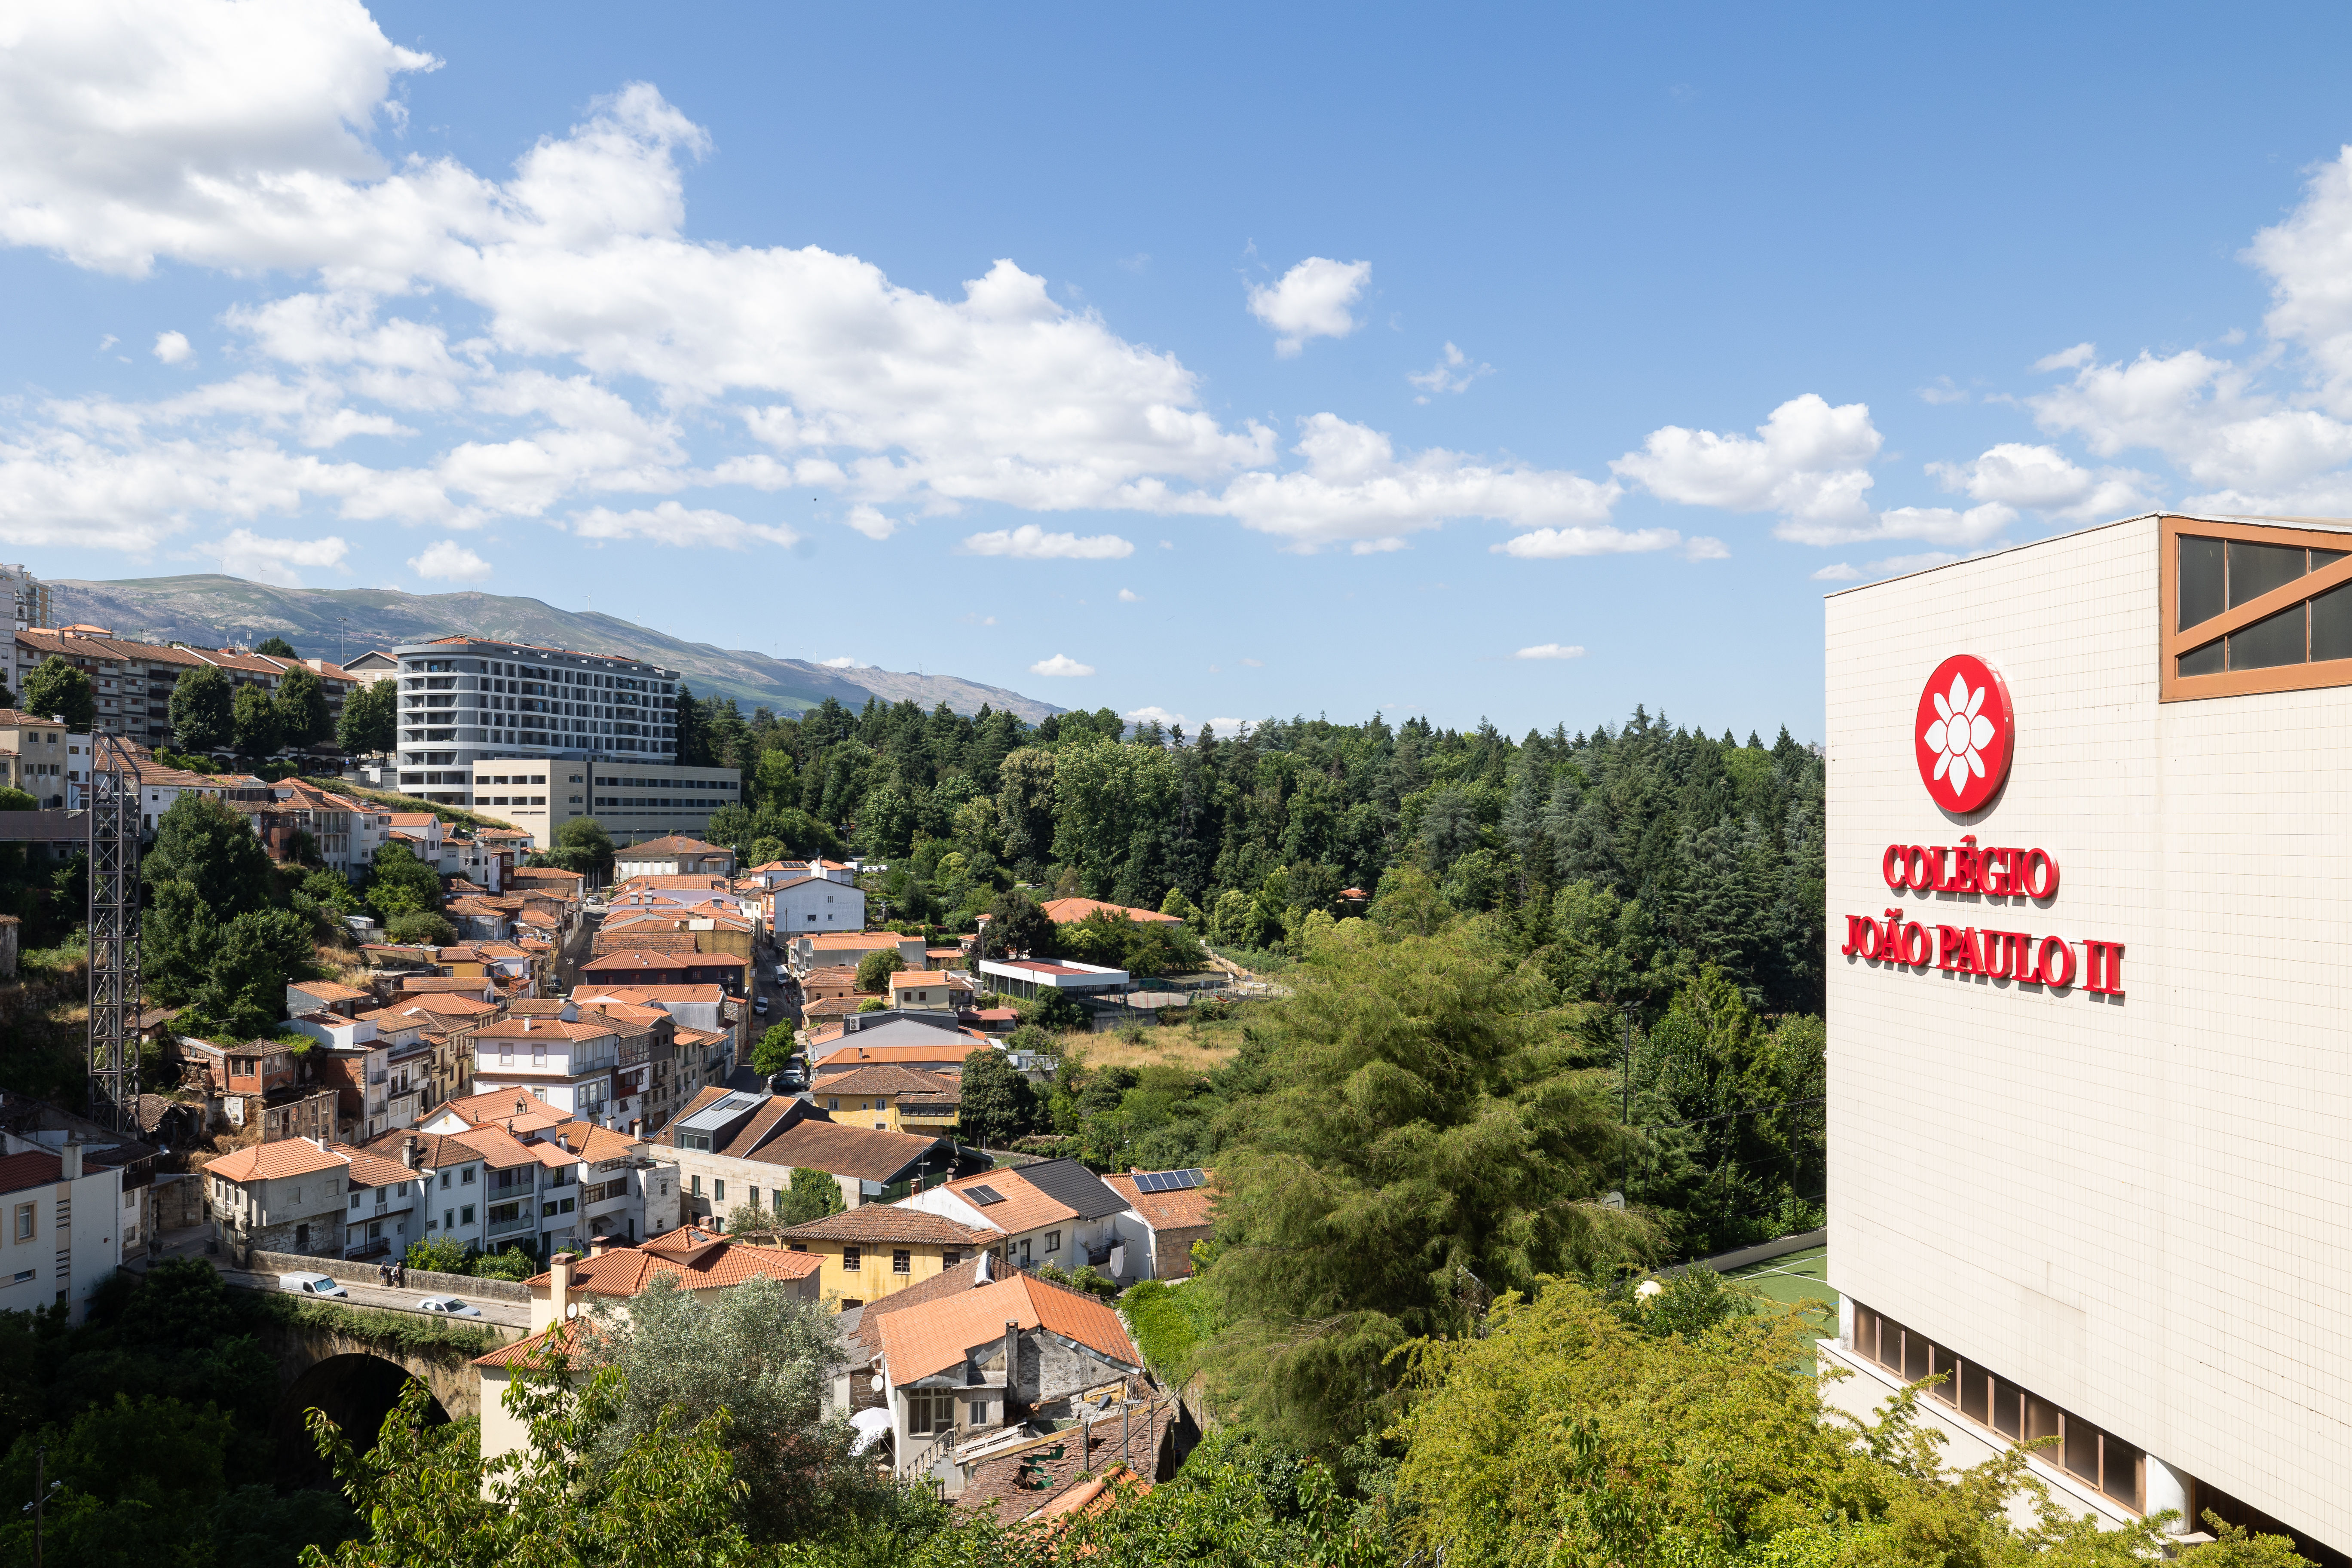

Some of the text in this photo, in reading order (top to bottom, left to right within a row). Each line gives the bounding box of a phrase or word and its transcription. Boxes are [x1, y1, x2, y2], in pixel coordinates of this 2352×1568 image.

[1883, 835, 2060, 898] COLÉGIO
[1842, 908, 2125, 995] JOÃO PAULO II
